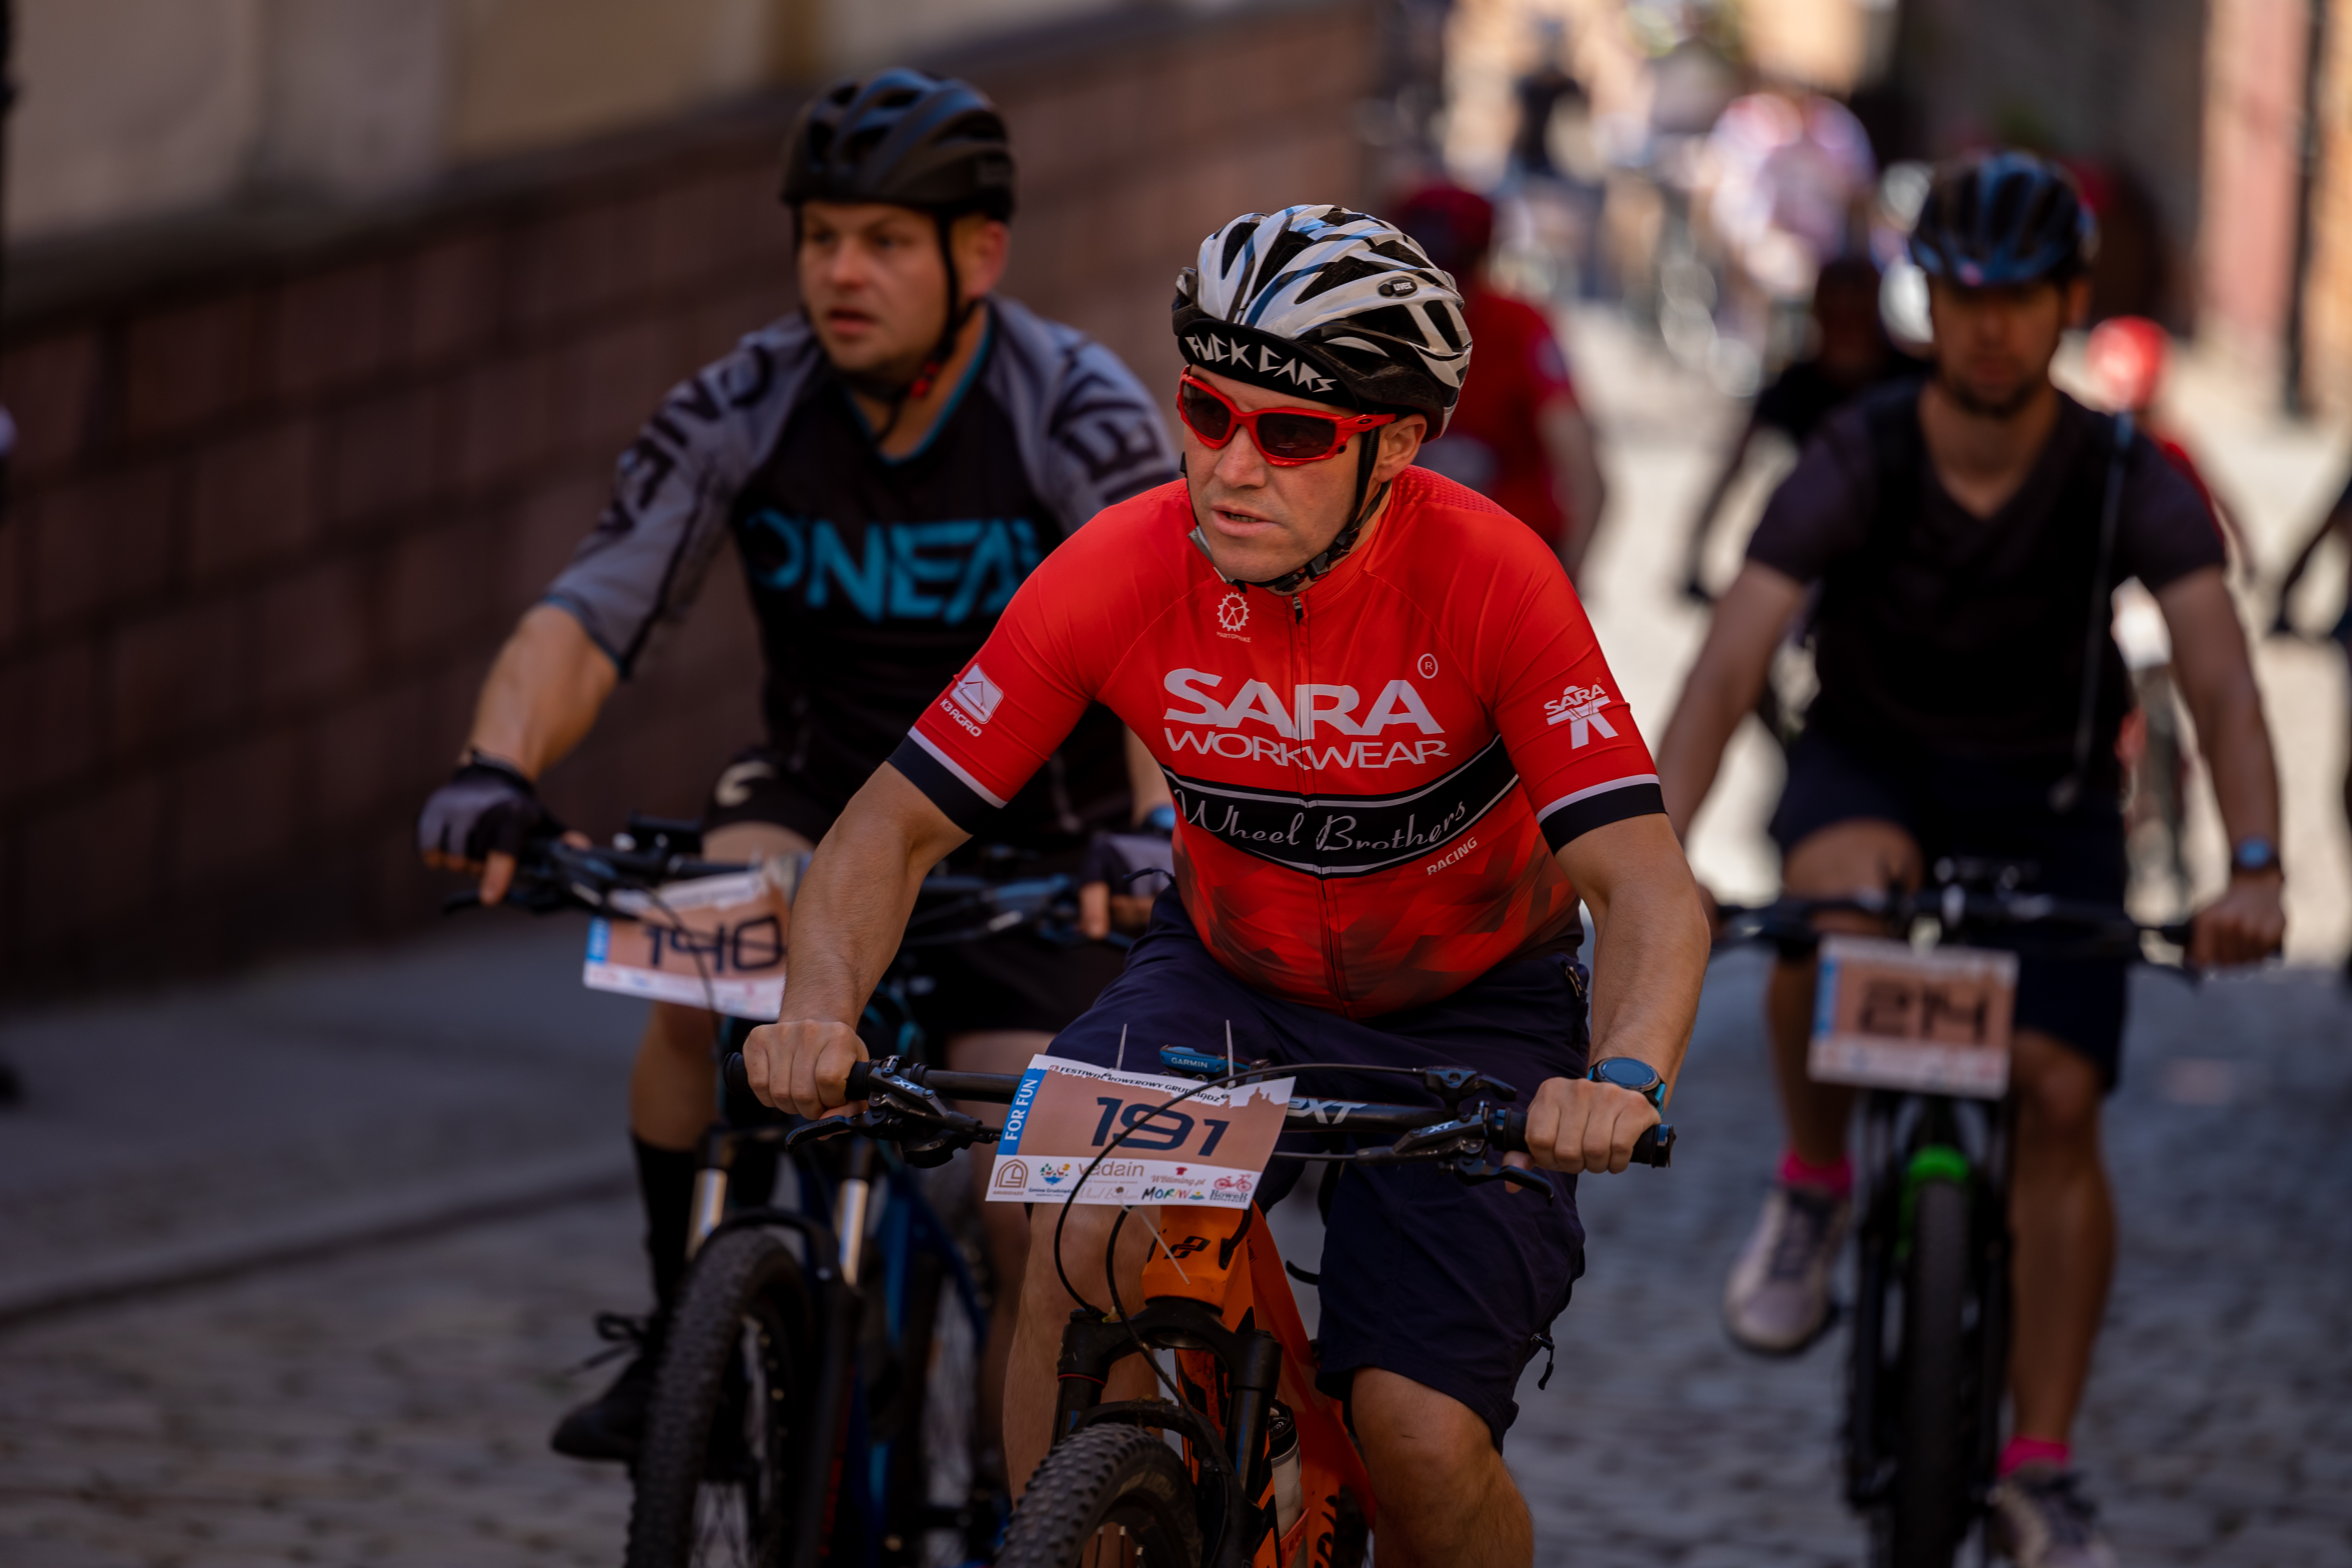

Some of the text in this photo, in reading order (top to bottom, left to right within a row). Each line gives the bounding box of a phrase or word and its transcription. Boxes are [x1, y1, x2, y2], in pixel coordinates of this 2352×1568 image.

[1185, 333, 1338, 392] FUCK CARS
[1164, 668, 1446, 740] SARA
[1544, 684, 1606, 716] SARA
[949, 708, 982, 737] AGRO
[1164, 727, 1451, 770] WORKWEAR
[1174, 789, 1465, 851] Wheel Brothers
[1426, 837, 1478, 876] RACING
[1107, 1076, 1164, 1089] ROWEROWY
[1171, 1057, 1208, 1069] GARMIN
[893, 1079, 919, 1090] XT
[1004, 1079, 1038, 1141] FOR FUN
[1091, 1096, 1230, 1157] 191
[1428, 1121, 1454, 1133] XT
